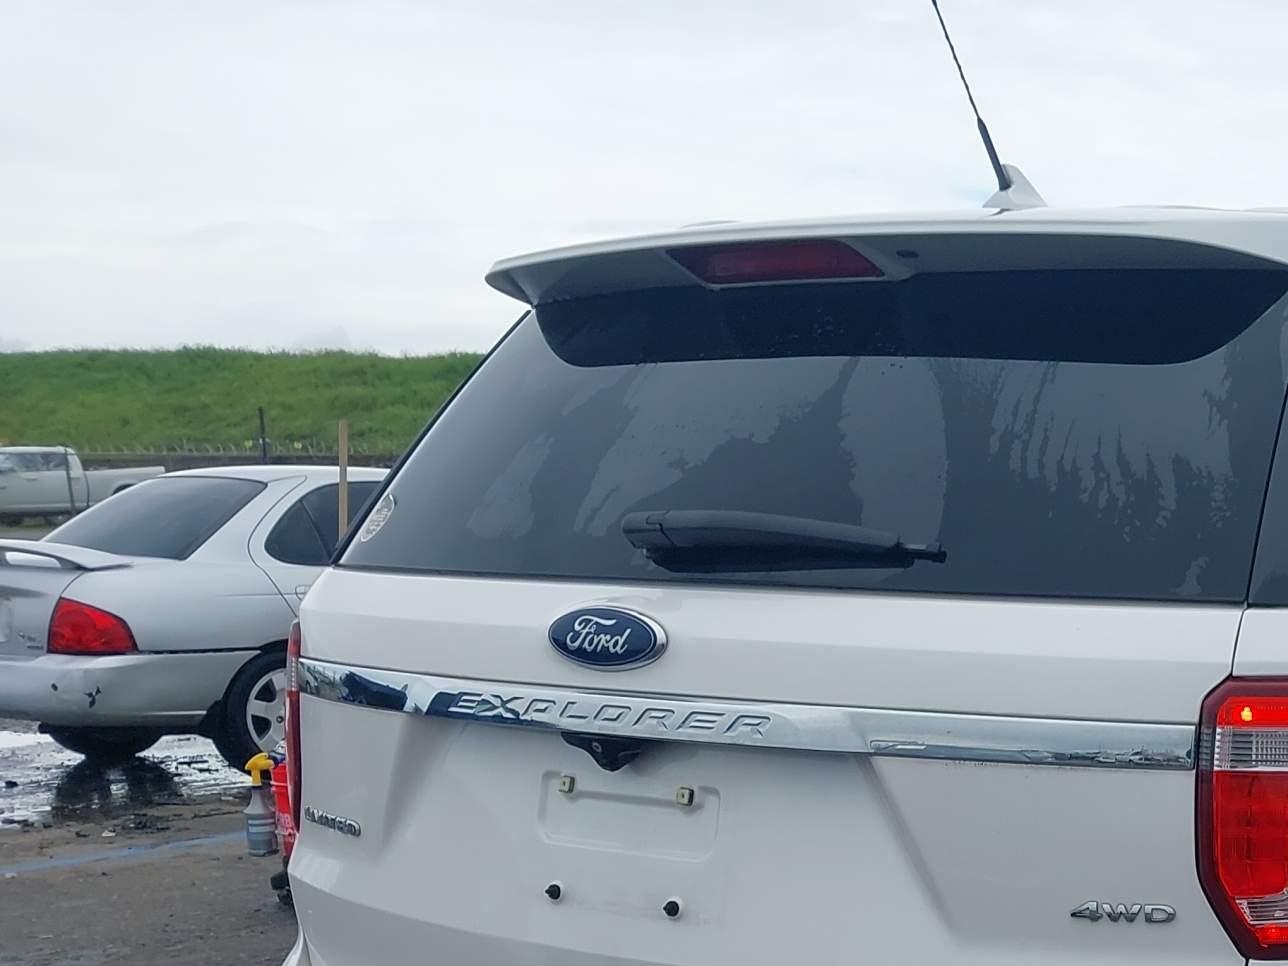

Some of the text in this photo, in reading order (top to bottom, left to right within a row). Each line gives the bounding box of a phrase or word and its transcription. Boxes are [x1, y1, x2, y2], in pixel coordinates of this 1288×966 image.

[566, 615, 632, 655] Ford
[448, 690, 773, 737] EXPLORER
[1070, 901, 1176, 923] 4WD
